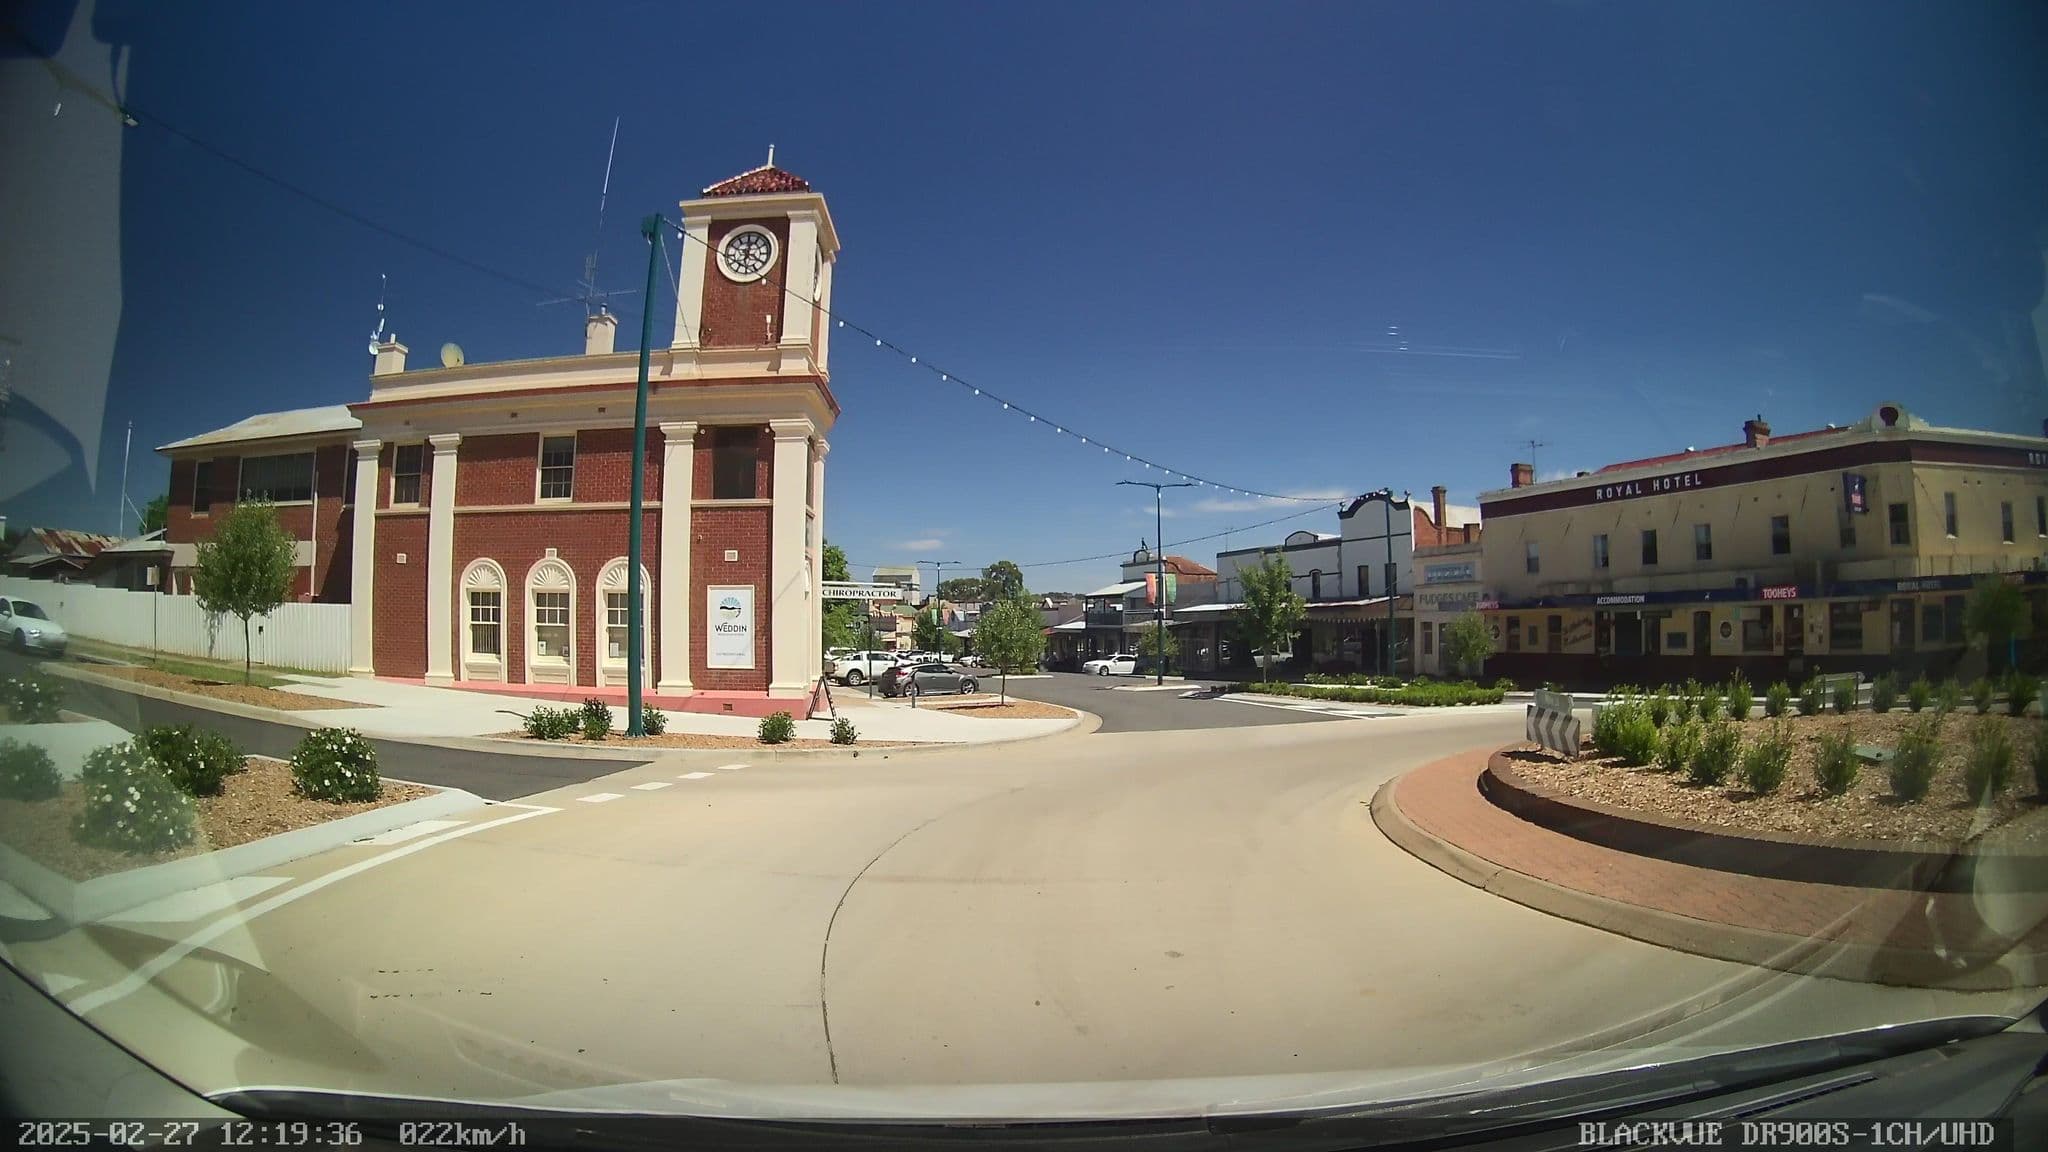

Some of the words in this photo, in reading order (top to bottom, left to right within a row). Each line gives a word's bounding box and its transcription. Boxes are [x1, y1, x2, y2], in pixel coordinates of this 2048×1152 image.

[1596, 483, 1642, 500] ROYAL
[1653, 474, 1701, 491] HOTEL
[822, 588, 897, 598] CHIROPRACTOR
[1762, 586, 1797, 599] TOOHEYS
[1596, 594, 1646, 605] ACCOMMODATION
[714, 622, 748, 633] WEDDIN
